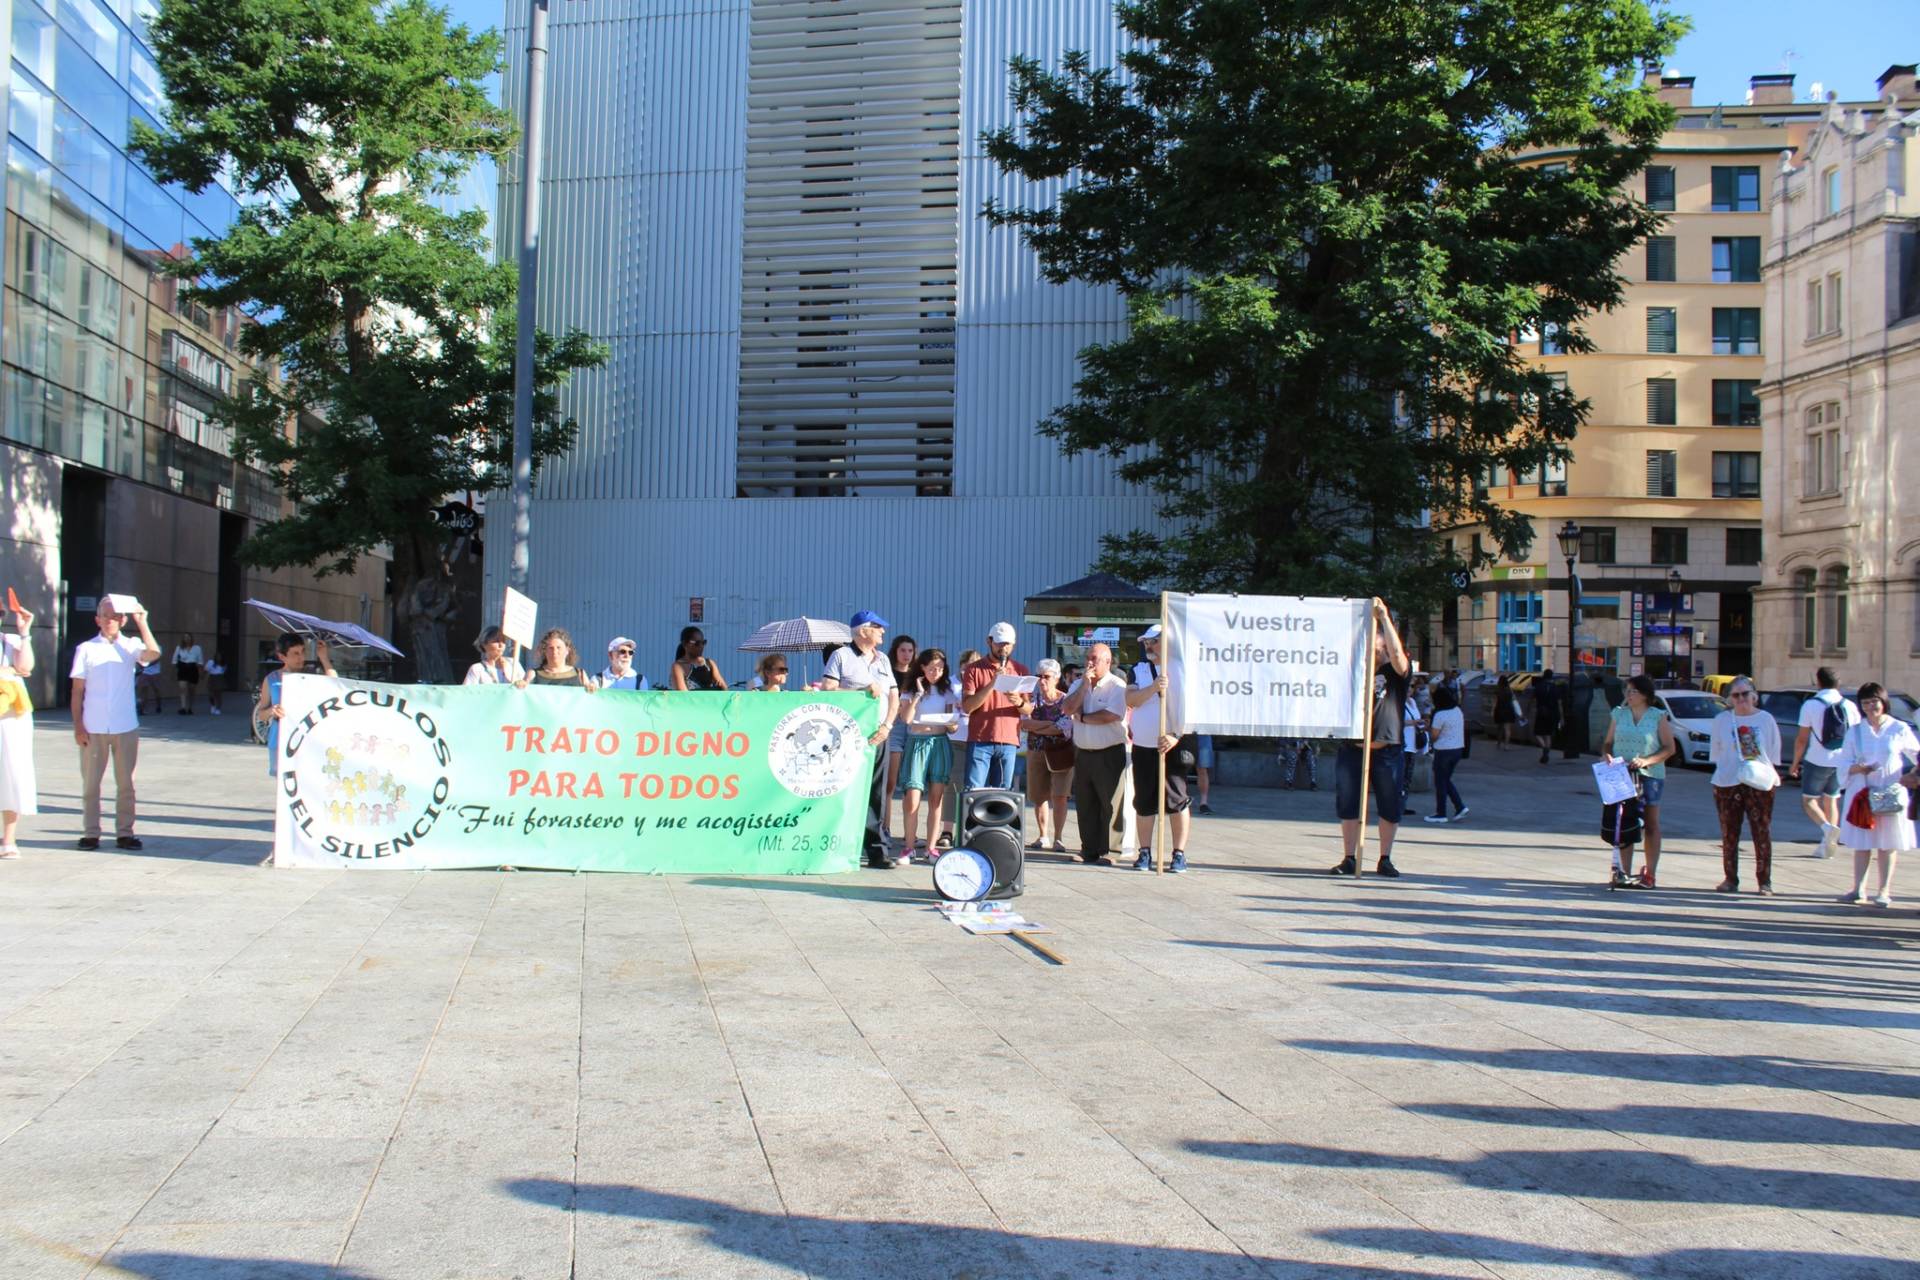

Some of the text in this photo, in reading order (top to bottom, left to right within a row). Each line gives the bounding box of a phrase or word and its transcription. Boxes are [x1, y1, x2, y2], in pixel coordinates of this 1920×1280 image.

[1223, 610, 1315, 632] Vuestra
[1729, 612, 1743, 629] 14
[1199, 643, 1339, 665] indiferencia
[1210, 677, 1327, 698] nos mata
[286, 690, 452, 767] CIRCULOS
[501, 725, 750, 757] TRATO DIGNO
[769, 713, 798, 752] PASTORAL
[801, 704, 821, 713] CON
[509, 769, 740, 799] PARA TODOS
[793, 785, 839, 797] BURGOS
[283, 770, 449, 859] DEL SILENCIO
[524, 807, 624, 835] forastero
[635, 816, 646, 837] y
[656, 816, 687, 829] me
[758, 835, 784, 855] (Mt.
[792, 835, 814, 852] 25,
